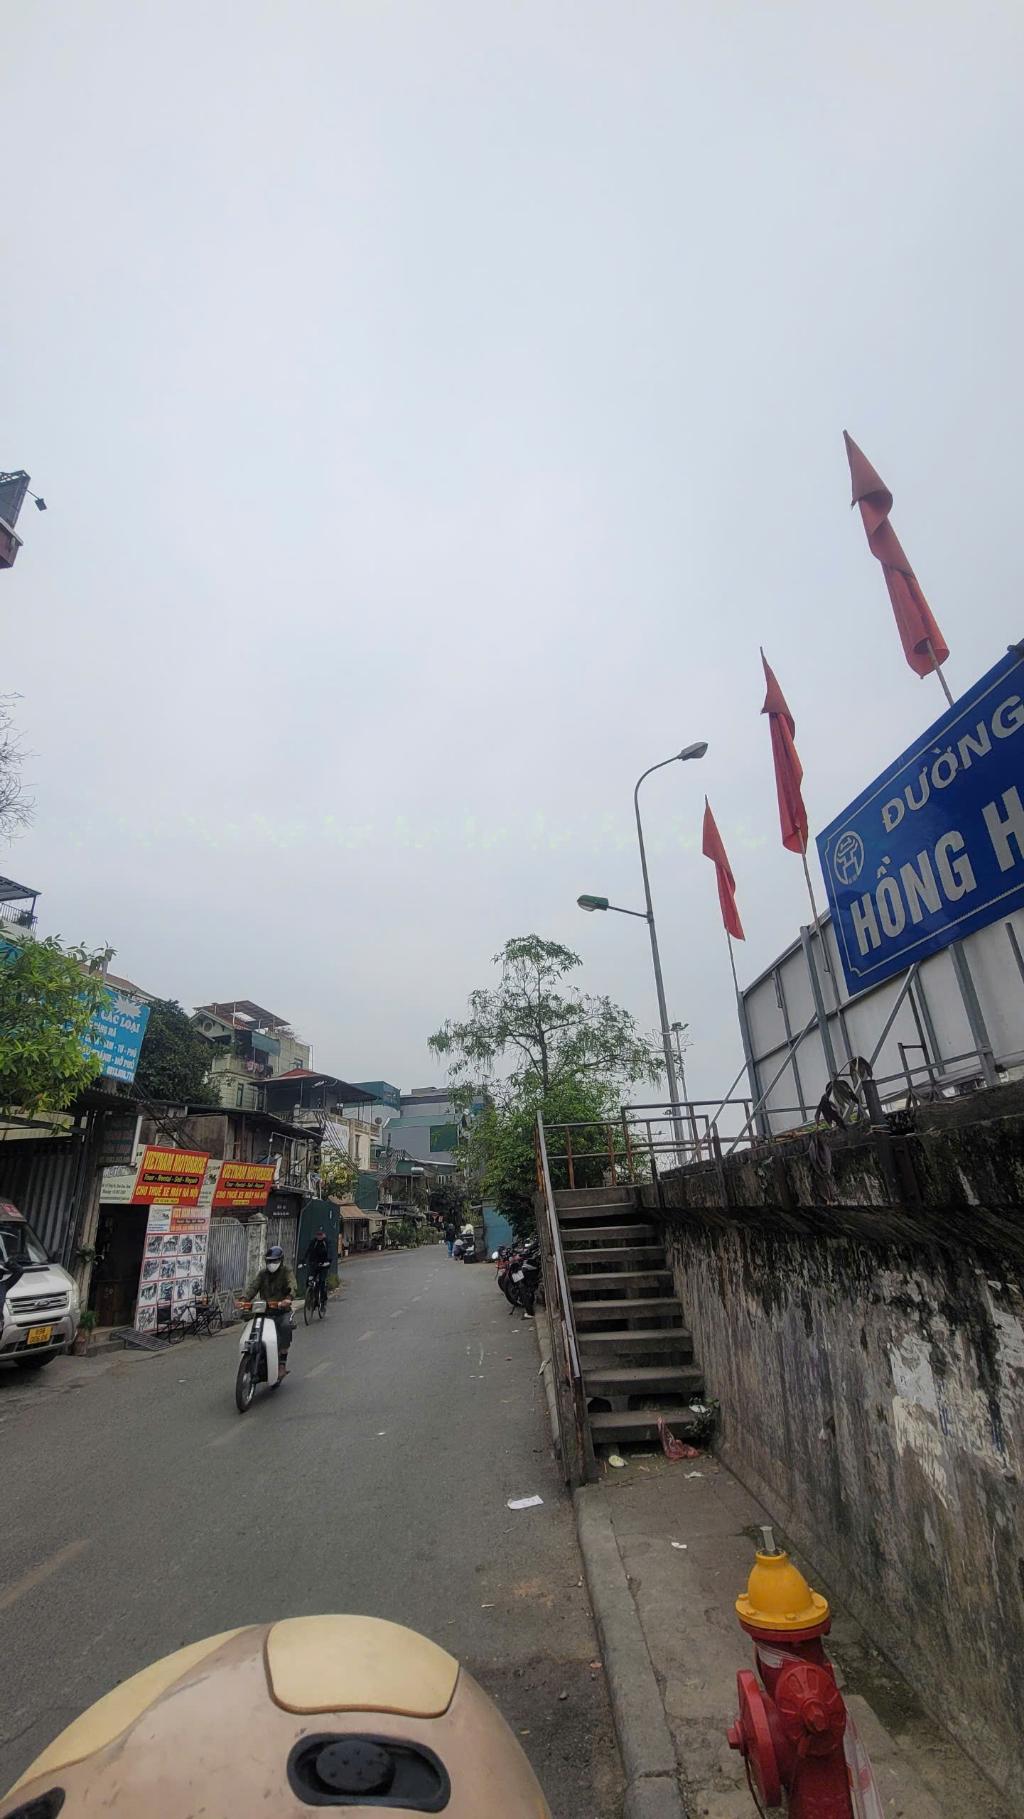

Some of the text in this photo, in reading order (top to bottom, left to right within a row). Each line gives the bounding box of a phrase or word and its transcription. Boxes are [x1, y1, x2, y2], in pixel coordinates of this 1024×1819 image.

[882, 694, 1024, 833] ĐƯỜNG
[850, 829, 977, 957] HỒNG
[120, 1017, 141, 1034] LOẠI
[144, 1151, 175, 1171] VIETNAM
[136, 1185, 148, 1195] CHO
